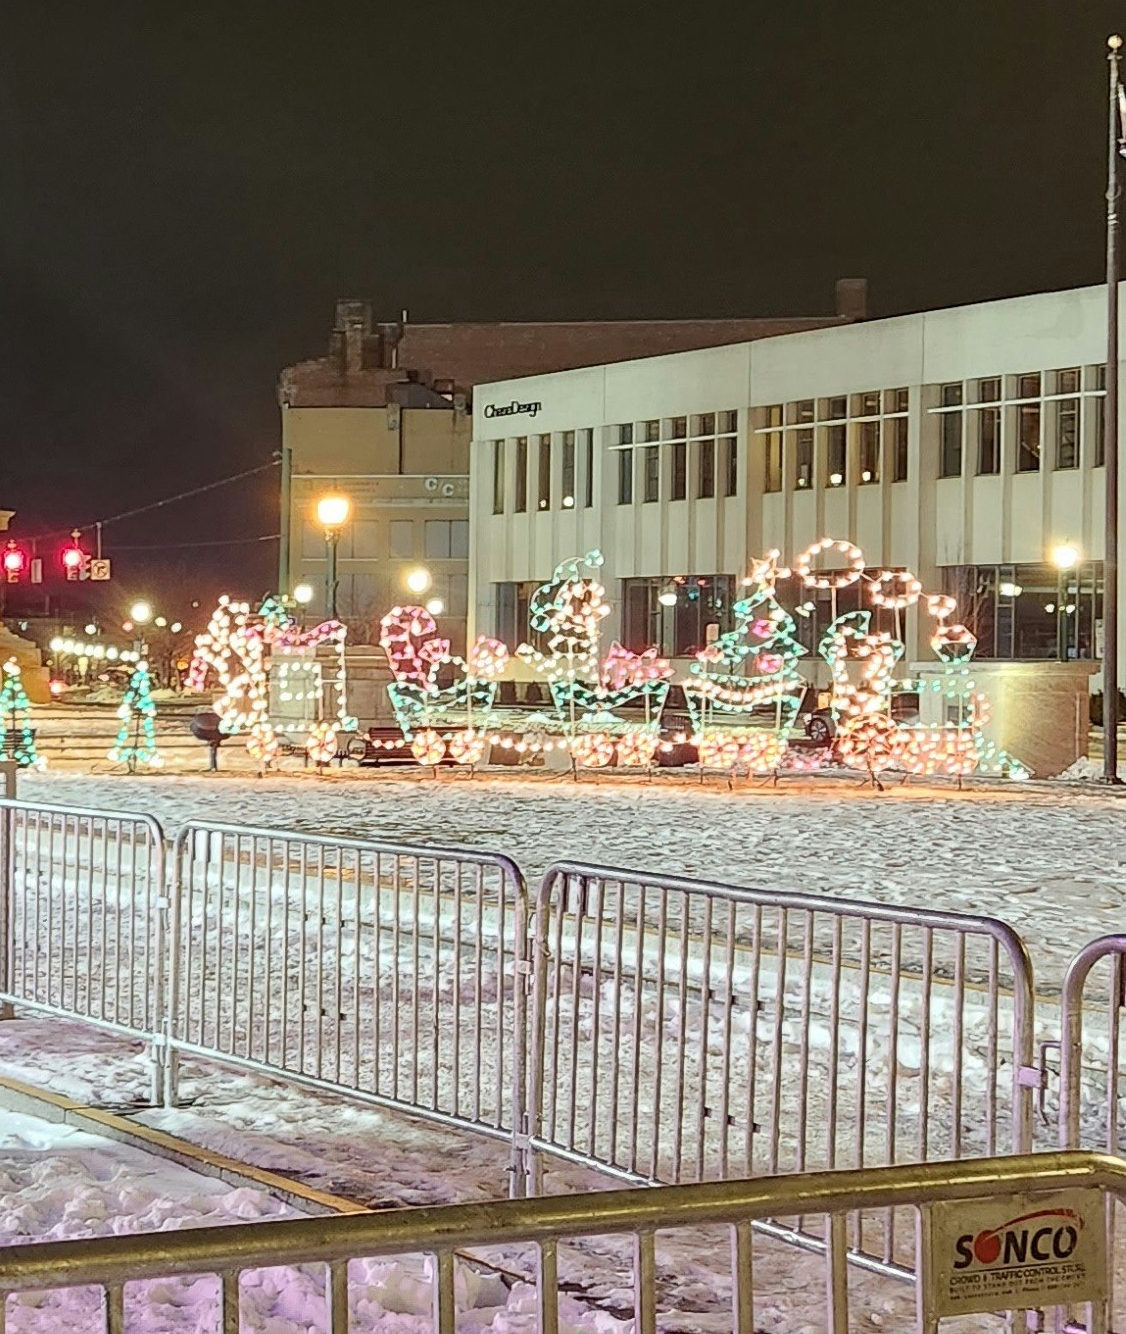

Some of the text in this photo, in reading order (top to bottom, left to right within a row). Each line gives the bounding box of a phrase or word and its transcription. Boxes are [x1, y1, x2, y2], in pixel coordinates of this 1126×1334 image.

[953, 1225, 1078, 1269] SONCO
[950, 1274, 981, 1286] CROWD
[990, 1269, 1023, 1280] TRAFFIC
[1023, 1266, 1061, 1277] CONTROL
